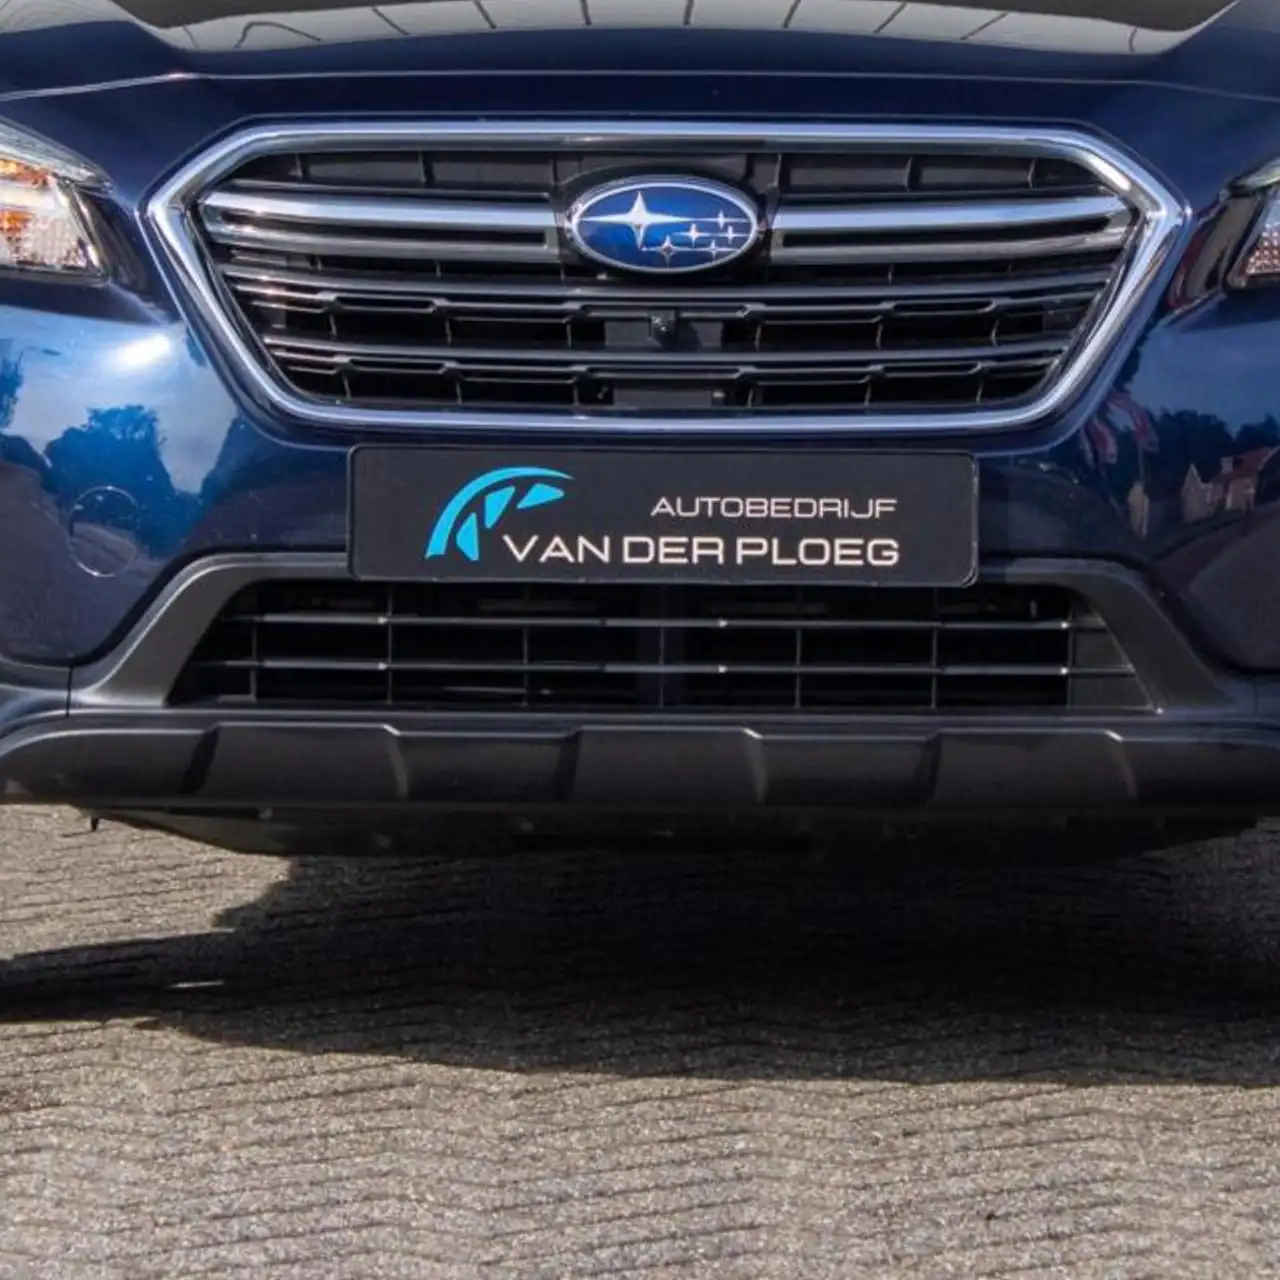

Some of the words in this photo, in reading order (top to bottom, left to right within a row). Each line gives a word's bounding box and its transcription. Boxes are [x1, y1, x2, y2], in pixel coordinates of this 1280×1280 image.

[650, 496, 898, 520] AUTOBEDRIJF
[502, 534, 611, 565] VAN
[623, 535, 726, 566] DER
[735, 536, 900, 567] PLOEG
